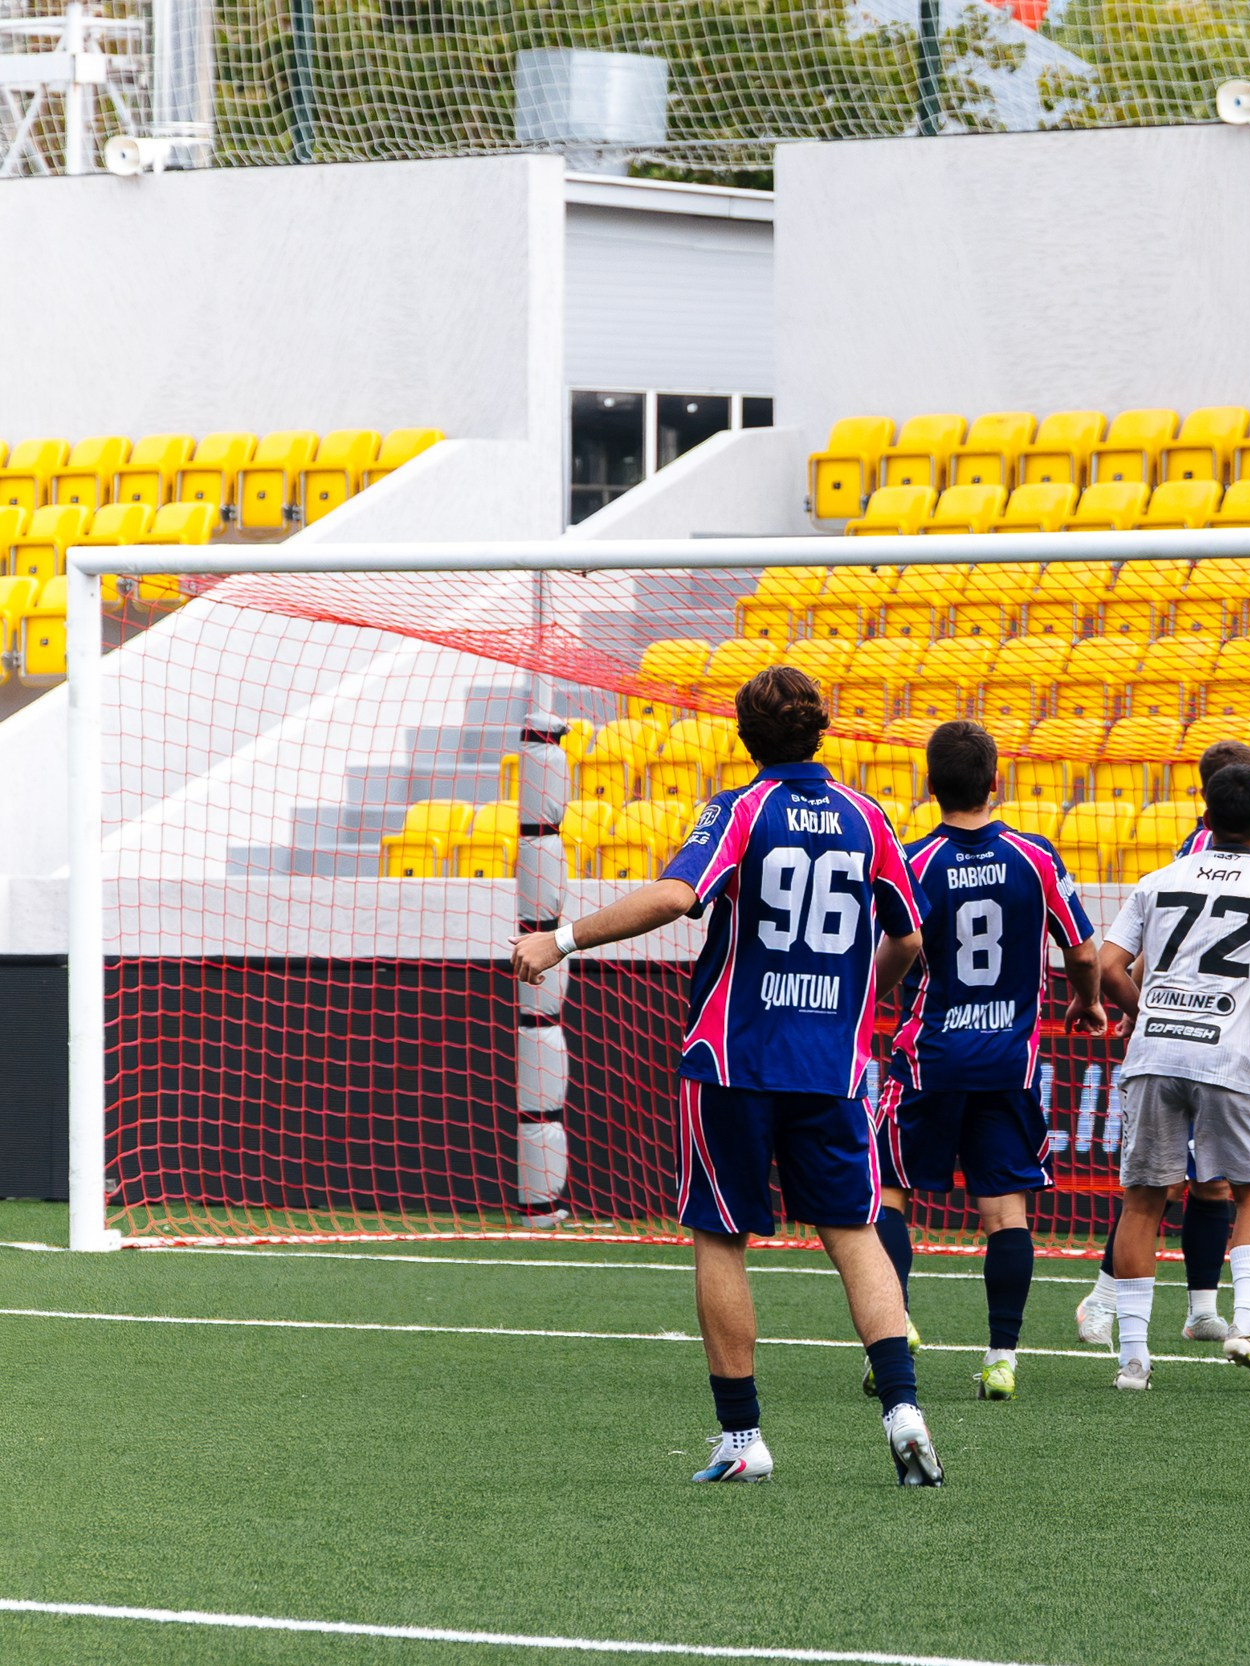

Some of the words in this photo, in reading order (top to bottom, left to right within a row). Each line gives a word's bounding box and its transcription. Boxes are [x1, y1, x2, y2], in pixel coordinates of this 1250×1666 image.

[946, 863, 1007, 889] BABKOV
[757, 847, 866, 955] 96
[956, 898, 1003, 986] 8
[941, 1000, 1016, 1033] QUANTUM
[1150, 992, 1216, 1009] WINLINE
